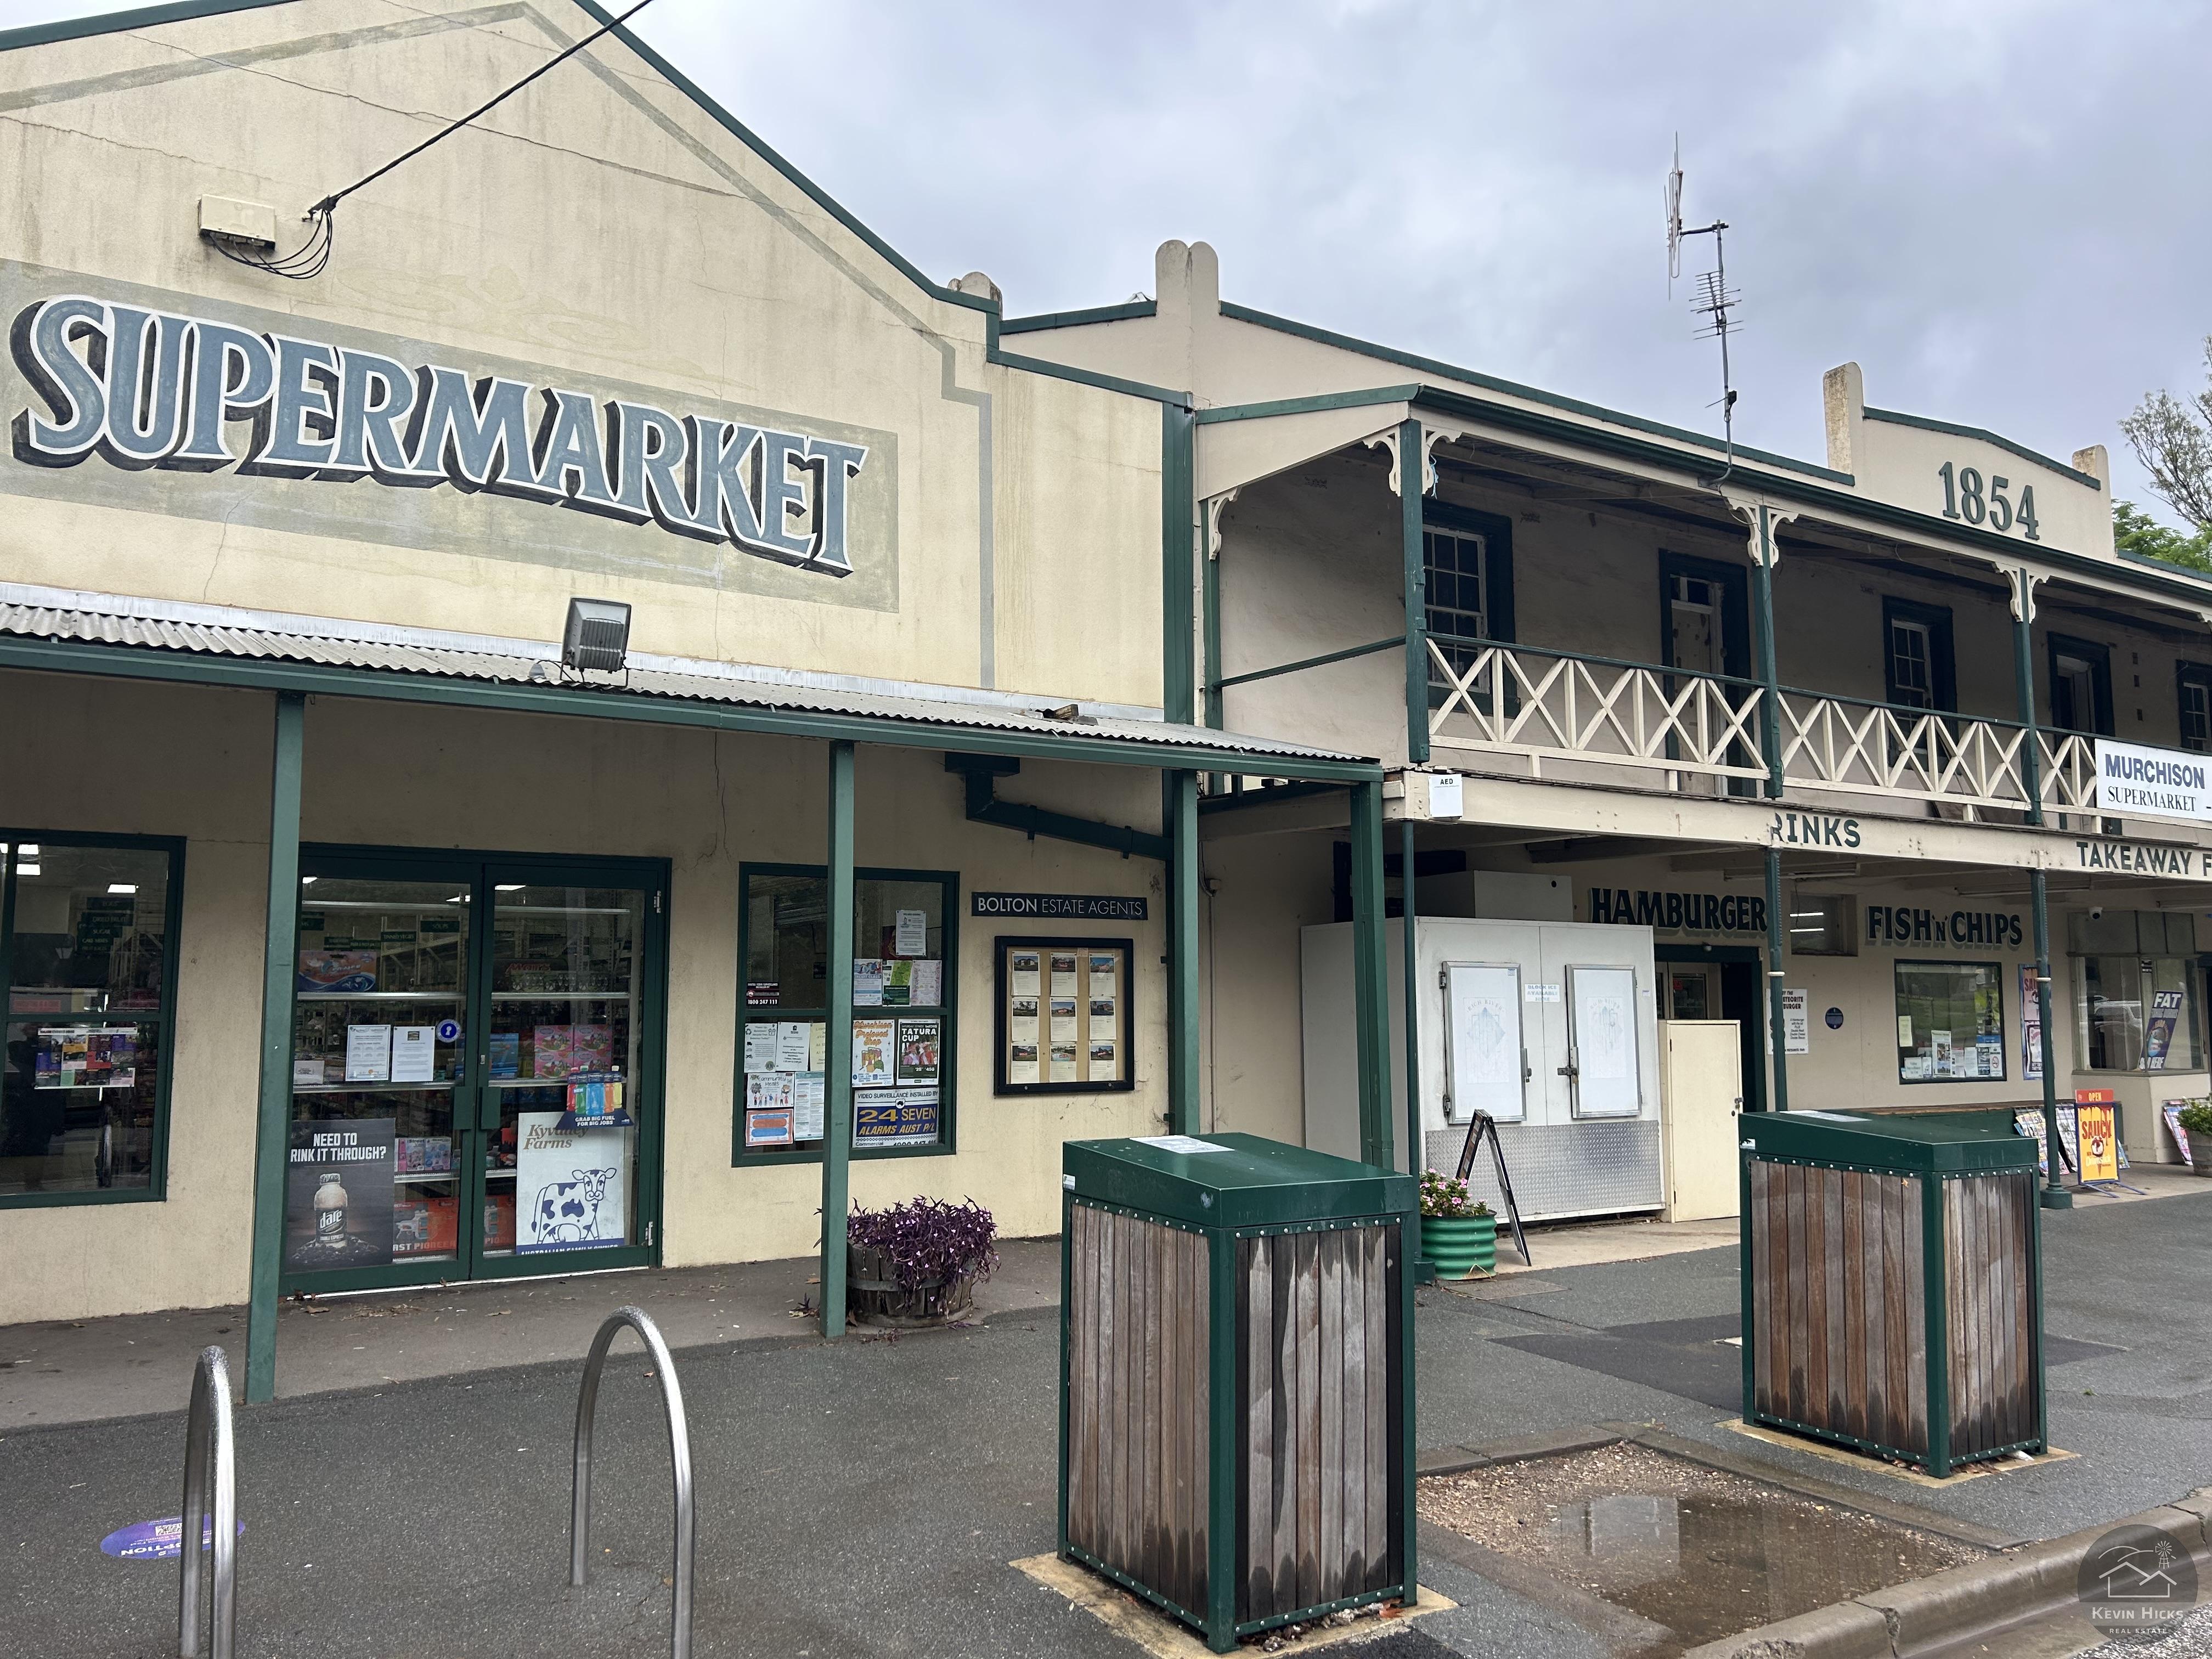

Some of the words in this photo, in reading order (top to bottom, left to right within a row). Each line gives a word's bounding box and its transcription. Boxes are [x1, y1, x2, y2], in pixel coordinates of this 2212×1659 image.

[10, 294, 869, 577] SUPERMARKET
[1939, 461, 2040, 540] 1854
[2104, 753, 2205, 789] MURCHISON
[2108, 786, 2197, 812] SUPERMARKET
[2076, 841, 2192, 875] TAKEAWAY
[978, 897, 1037, 912] BOLTON
[1042, 899, 1085, 913] ESTATE
[1088, 900, 1142, 915] AGENTS
[1589, 887, 1768, 933] HAMBURGER
[1866, 905, 1932, 942] FISH
[1950, 911, 2023, 946] CHIPS
[2153, 992, 2181, 1008] FAT
[2151, 1057, 2165, 1069] HERE
[2088, 1092, 2102, 1102] OPEN
[859, 1109, 899, 1123] 24
[901, 1107, 936, 1121] SEVEN
[858, 1125, 898, 1136] ALARMS
[899, 1124, 922, 1134] AUST
[923, 1122, 935, 1132] P/L
[2081, 1120, 2112, 1139] SAUCY
[313, 1133, 341, 1147] NEED
[343, 1132, 357, 1146] TO
[523, 1137, 573, 1150] Farms
[290, 1148, 315, 1163] RINK
[317, 1148, 328, 1161] IT
[330, 1146, 387, 1161] THROUGH?
[319, 1210, 342, 1229] dare
[392, 1243, 412, 1252] AST
